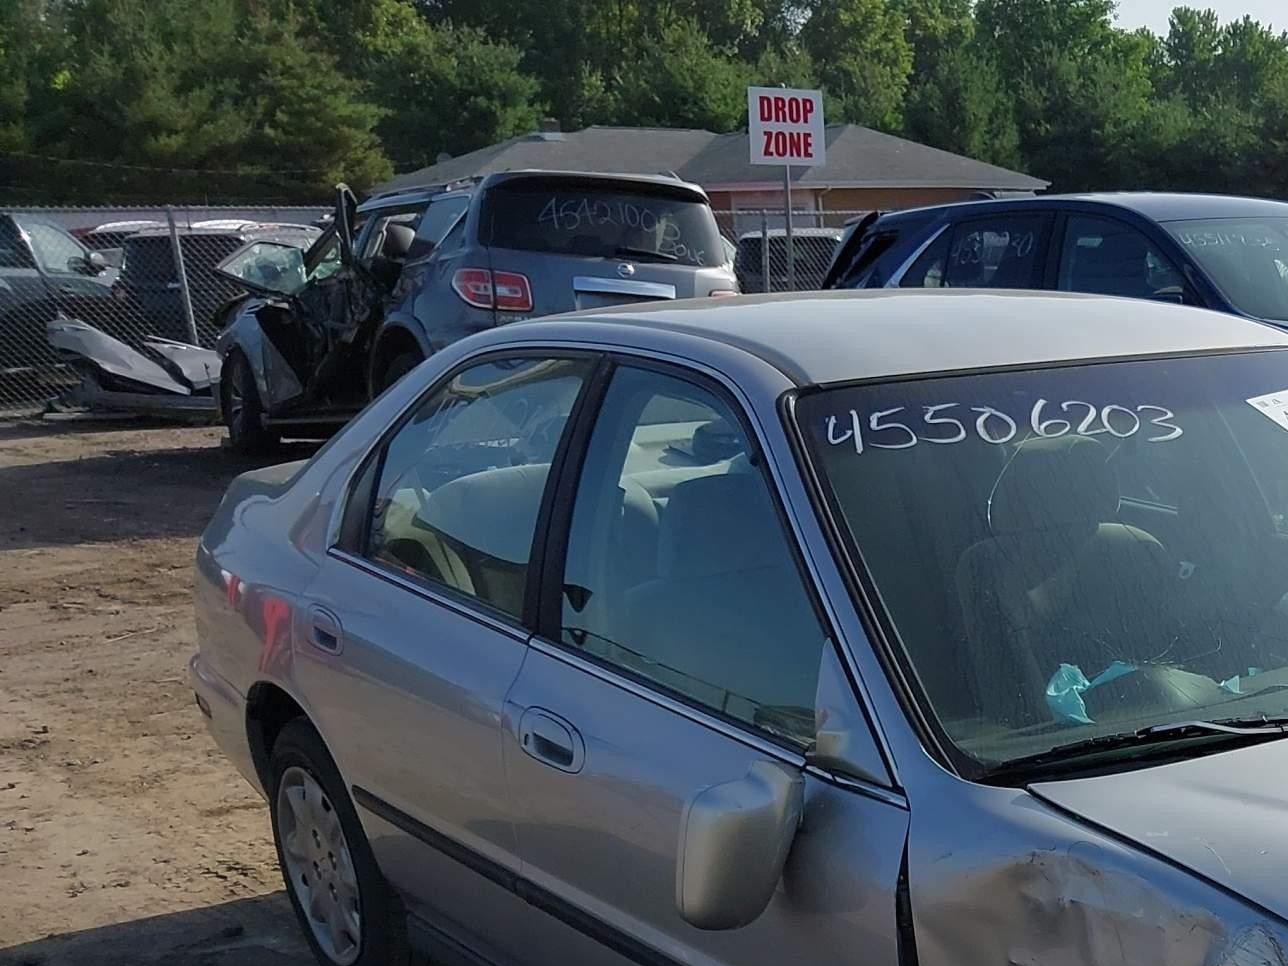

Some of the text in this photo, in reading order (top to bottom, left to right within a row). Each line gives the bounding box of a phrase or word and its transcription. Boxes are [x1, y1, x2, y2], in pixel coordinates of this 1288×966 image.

[758, 95, 814, 124] DROP
[763, 131, 813, 158] ZONE
[825, 399, 1184, 454] 45506203
